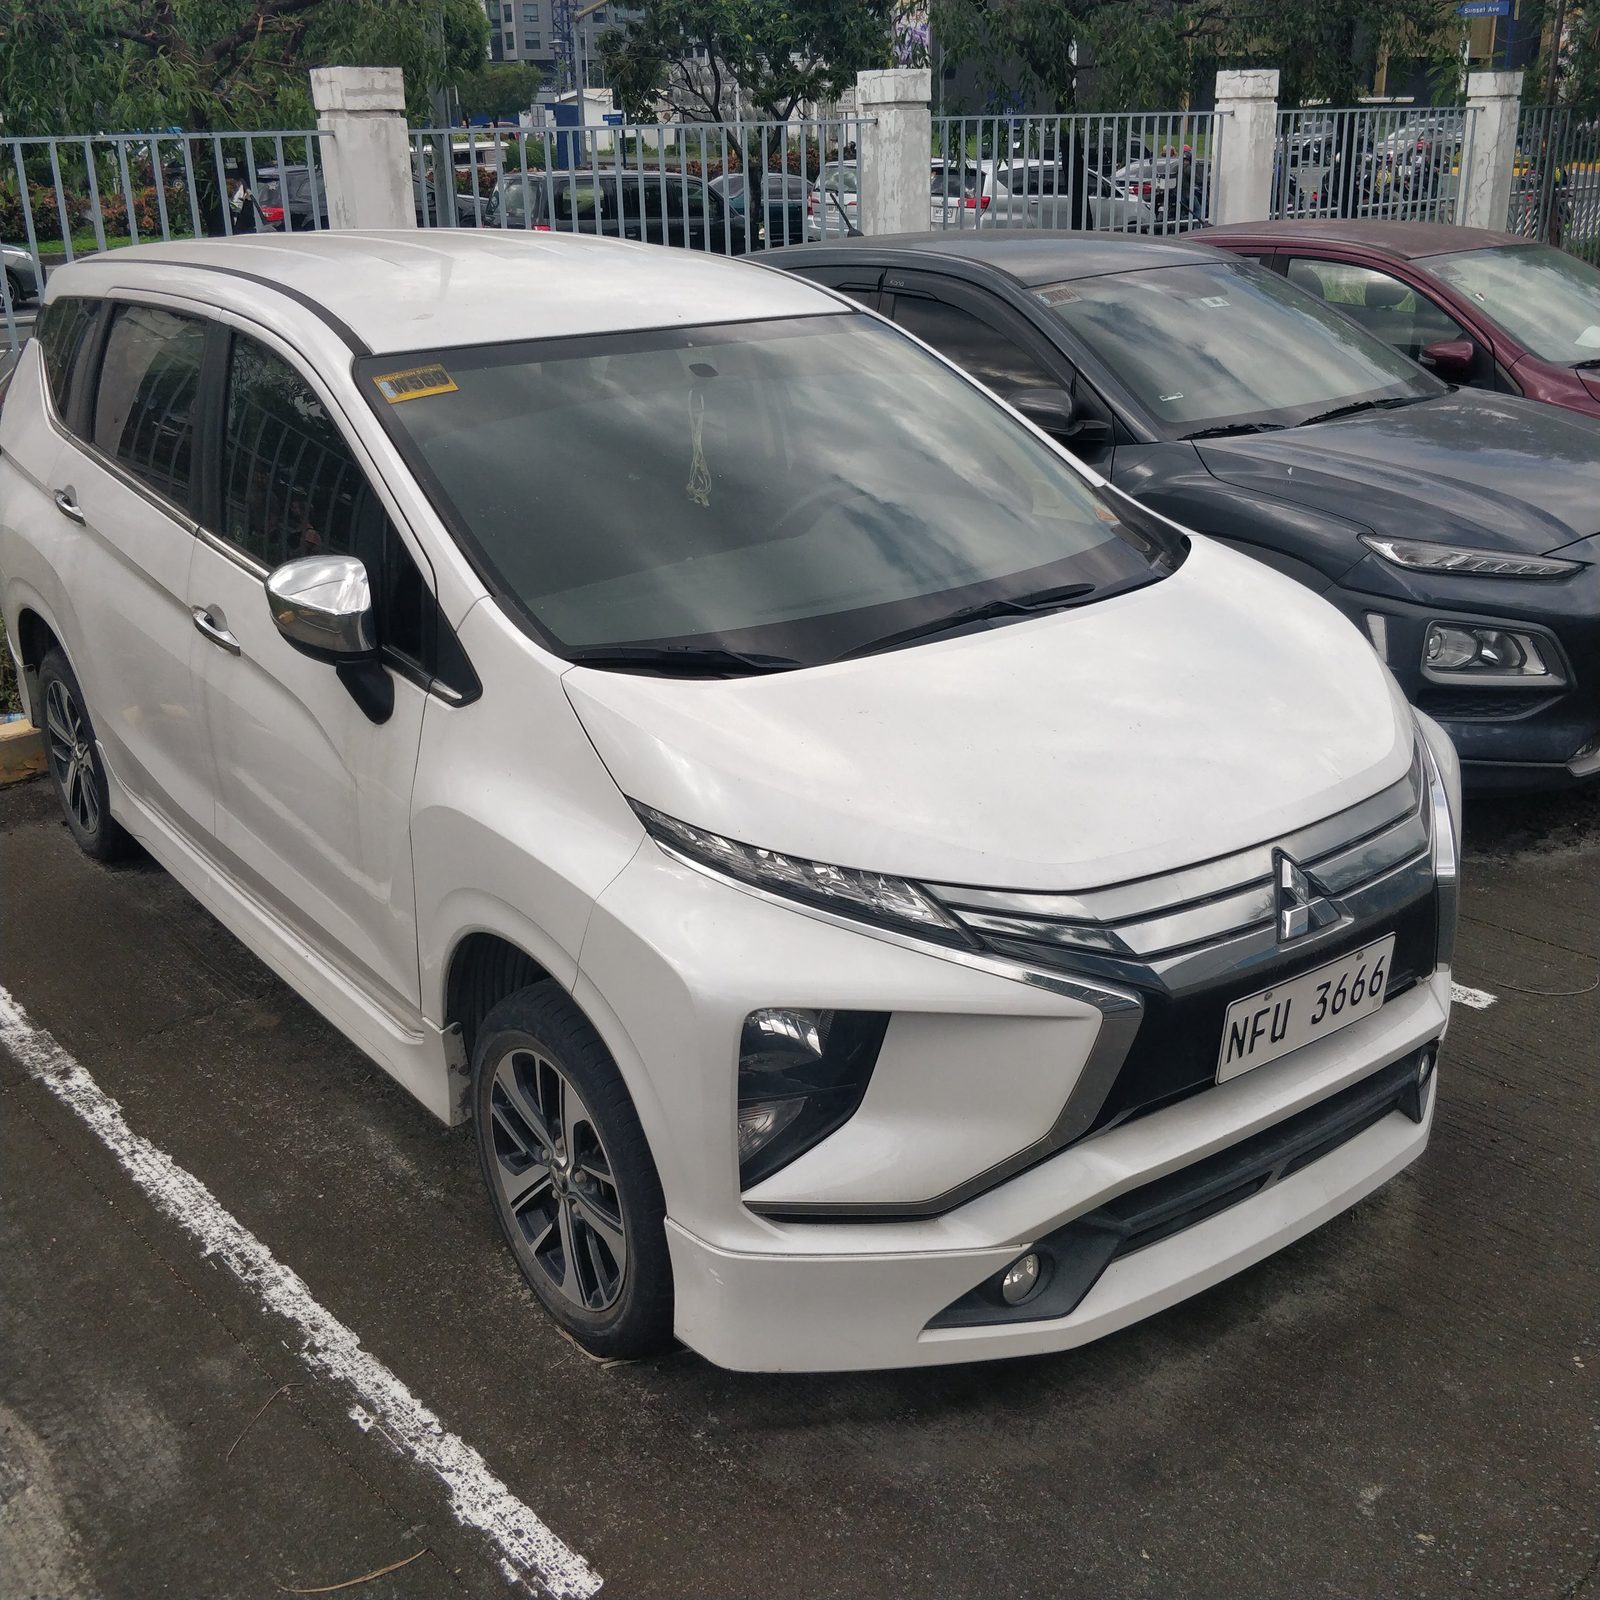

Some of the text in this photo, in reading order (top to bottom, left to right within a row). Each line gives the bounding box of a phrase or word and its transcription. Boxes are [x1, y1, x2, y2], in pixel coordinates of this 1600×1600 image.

[1464, 6, 1486, 14] Sunset
[1226, 955, 1385, 1064] NFU 3666
